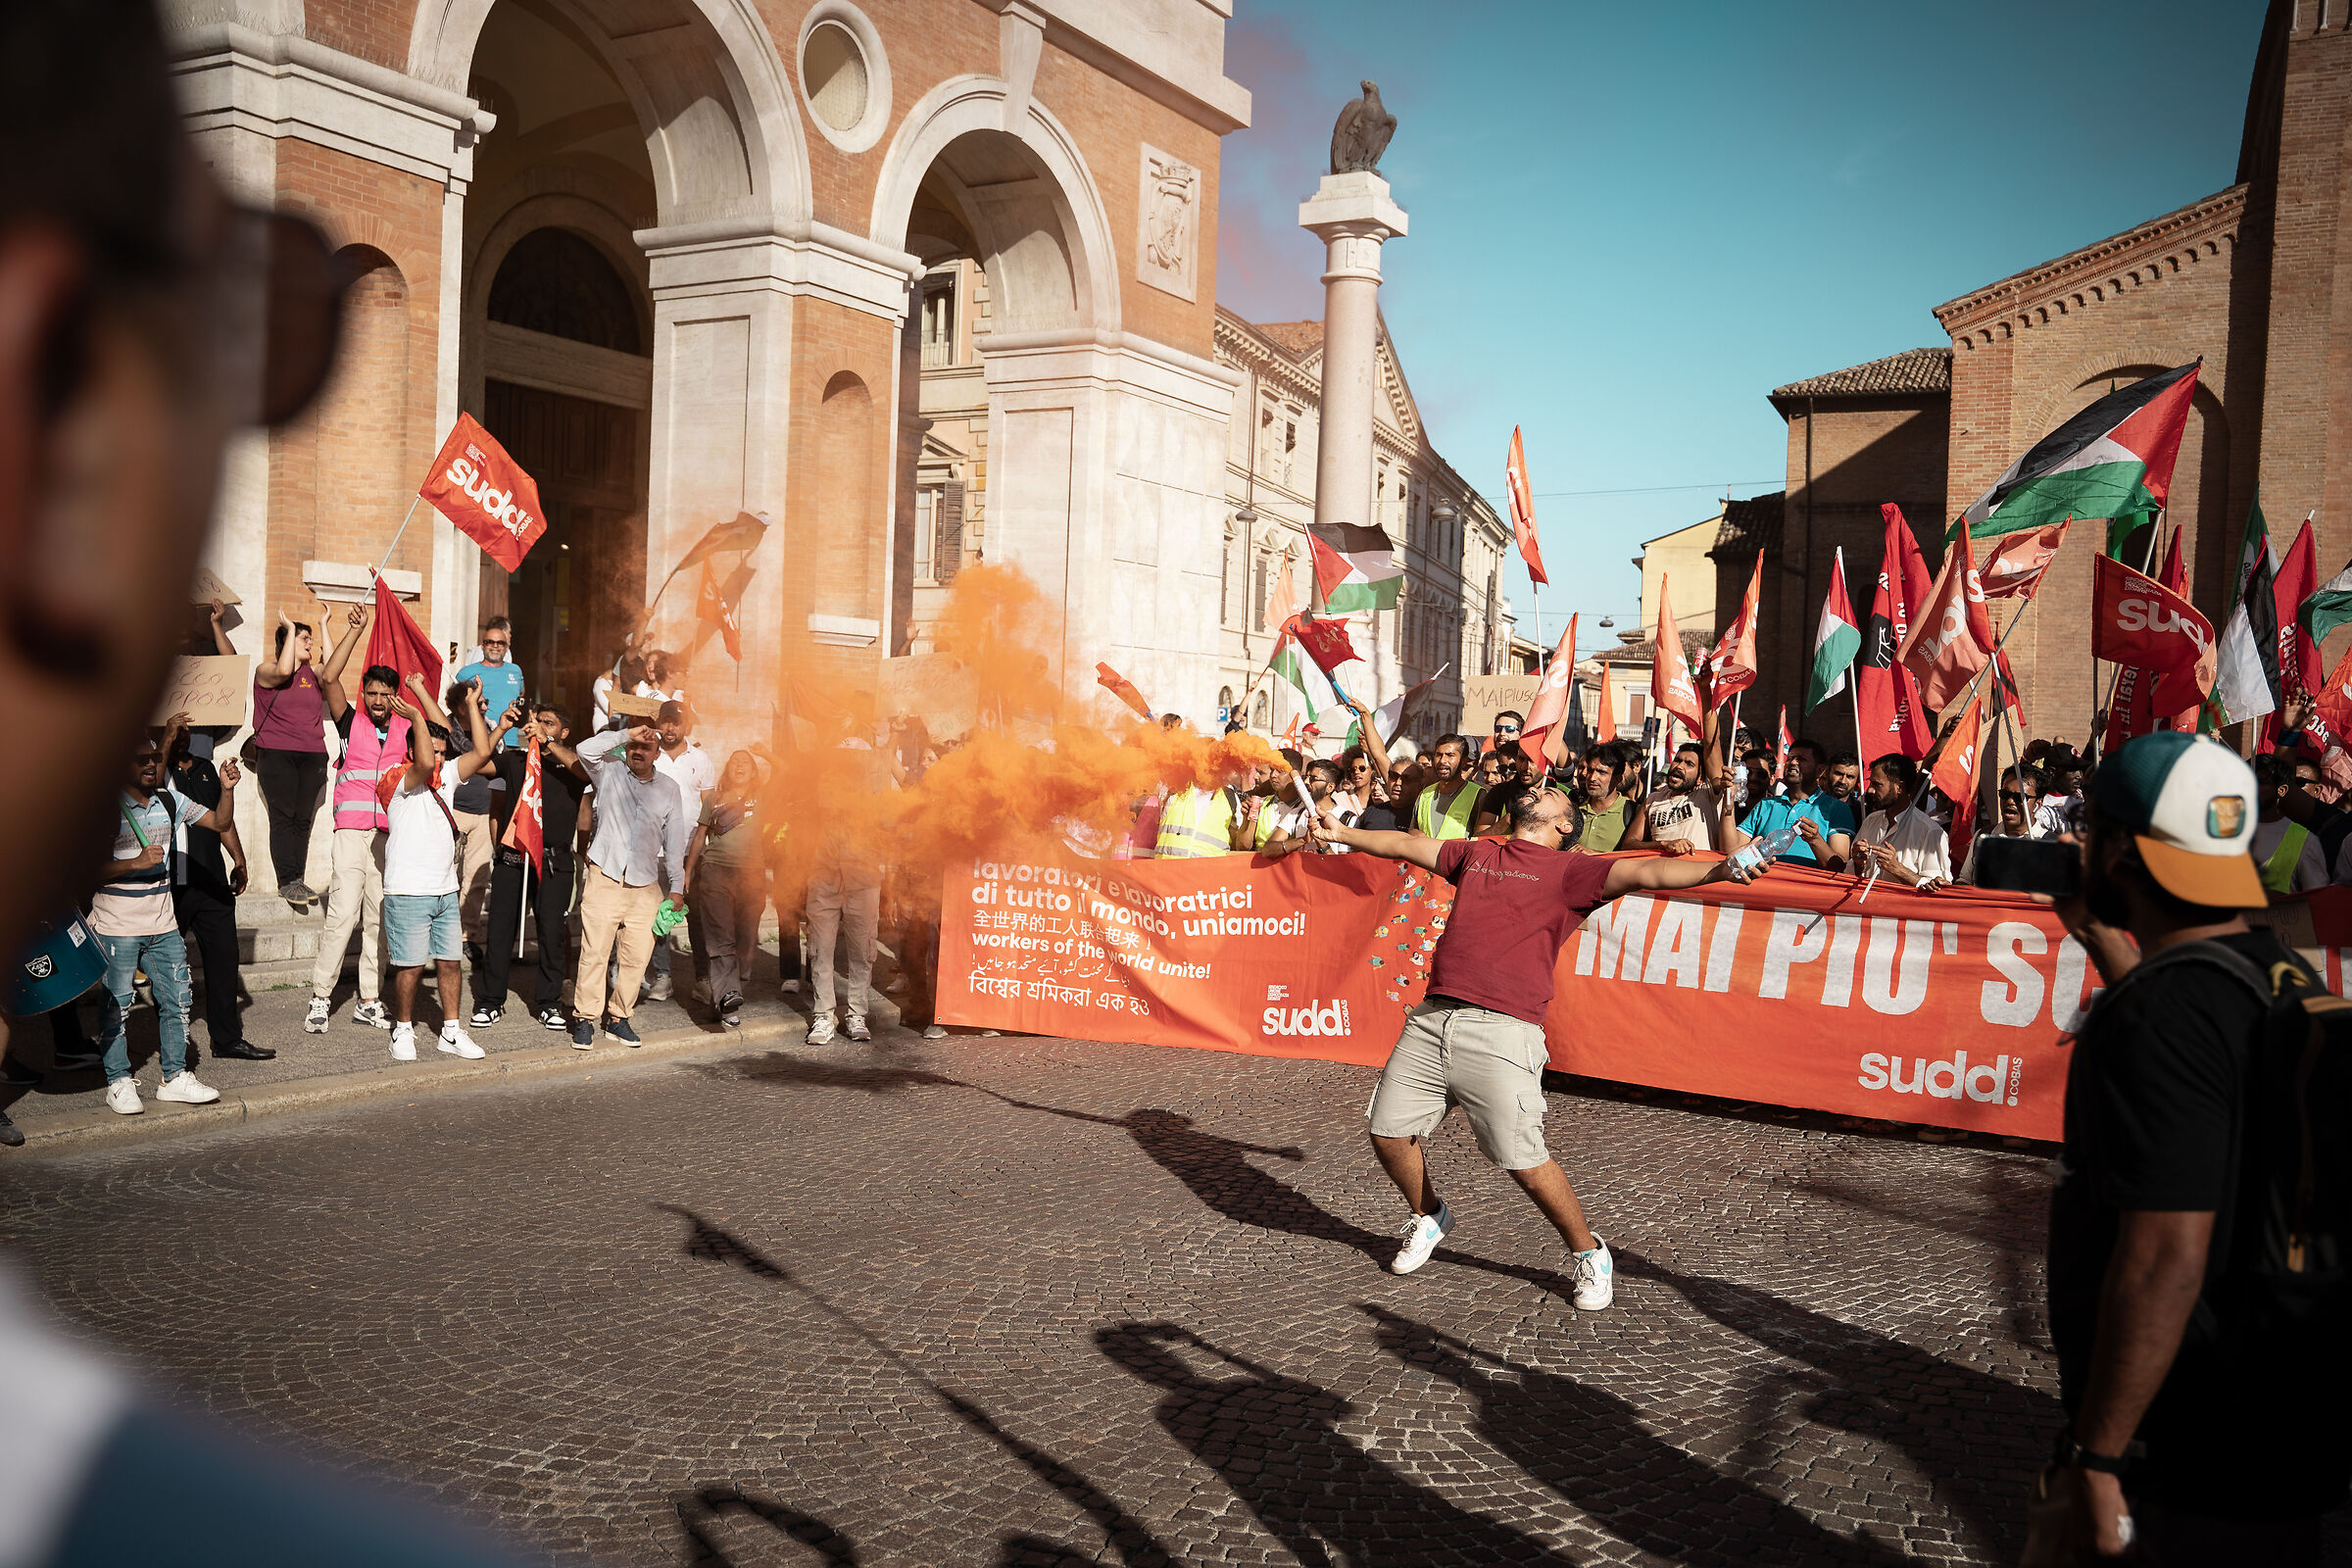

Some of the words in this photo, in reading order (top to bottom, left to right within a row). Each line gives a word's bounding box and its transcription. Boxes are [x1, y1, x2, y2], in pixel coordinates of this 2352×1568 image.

[2117, 599, 2208, 655] sud
[973, 857, 1102, 894] lavoratori
[1107, 879, 1120, 897] e
[1121, 884, 1252, 912] lavoratrici
[971, 882, 998, 905] di
[1005, 884, 1071, 911] tutto
[1077, 892, 1087, 913] il
[1091, 899, 1176, 939] mondo,
[1183, 910, 1306, 936] uniamoci!
[972, 932, 1050, 952] workers
[1054, 939, 1073, 955] of
[1078, 941, 1104, 958] the
[1106, 949, 1152, 971] world
[1158, 962, 1211, 979] unite!
[1575, 894, 1743, 993] MAI
[1758, 907, 1958, 1015] PIU'
[1980, 921, 2103, 1033] SC
[1096, 992, 1126, 1011] এক
[1341, 999, 1350, 1028] COBAS
[2009, 1056, 2023, 1096] COBAS
